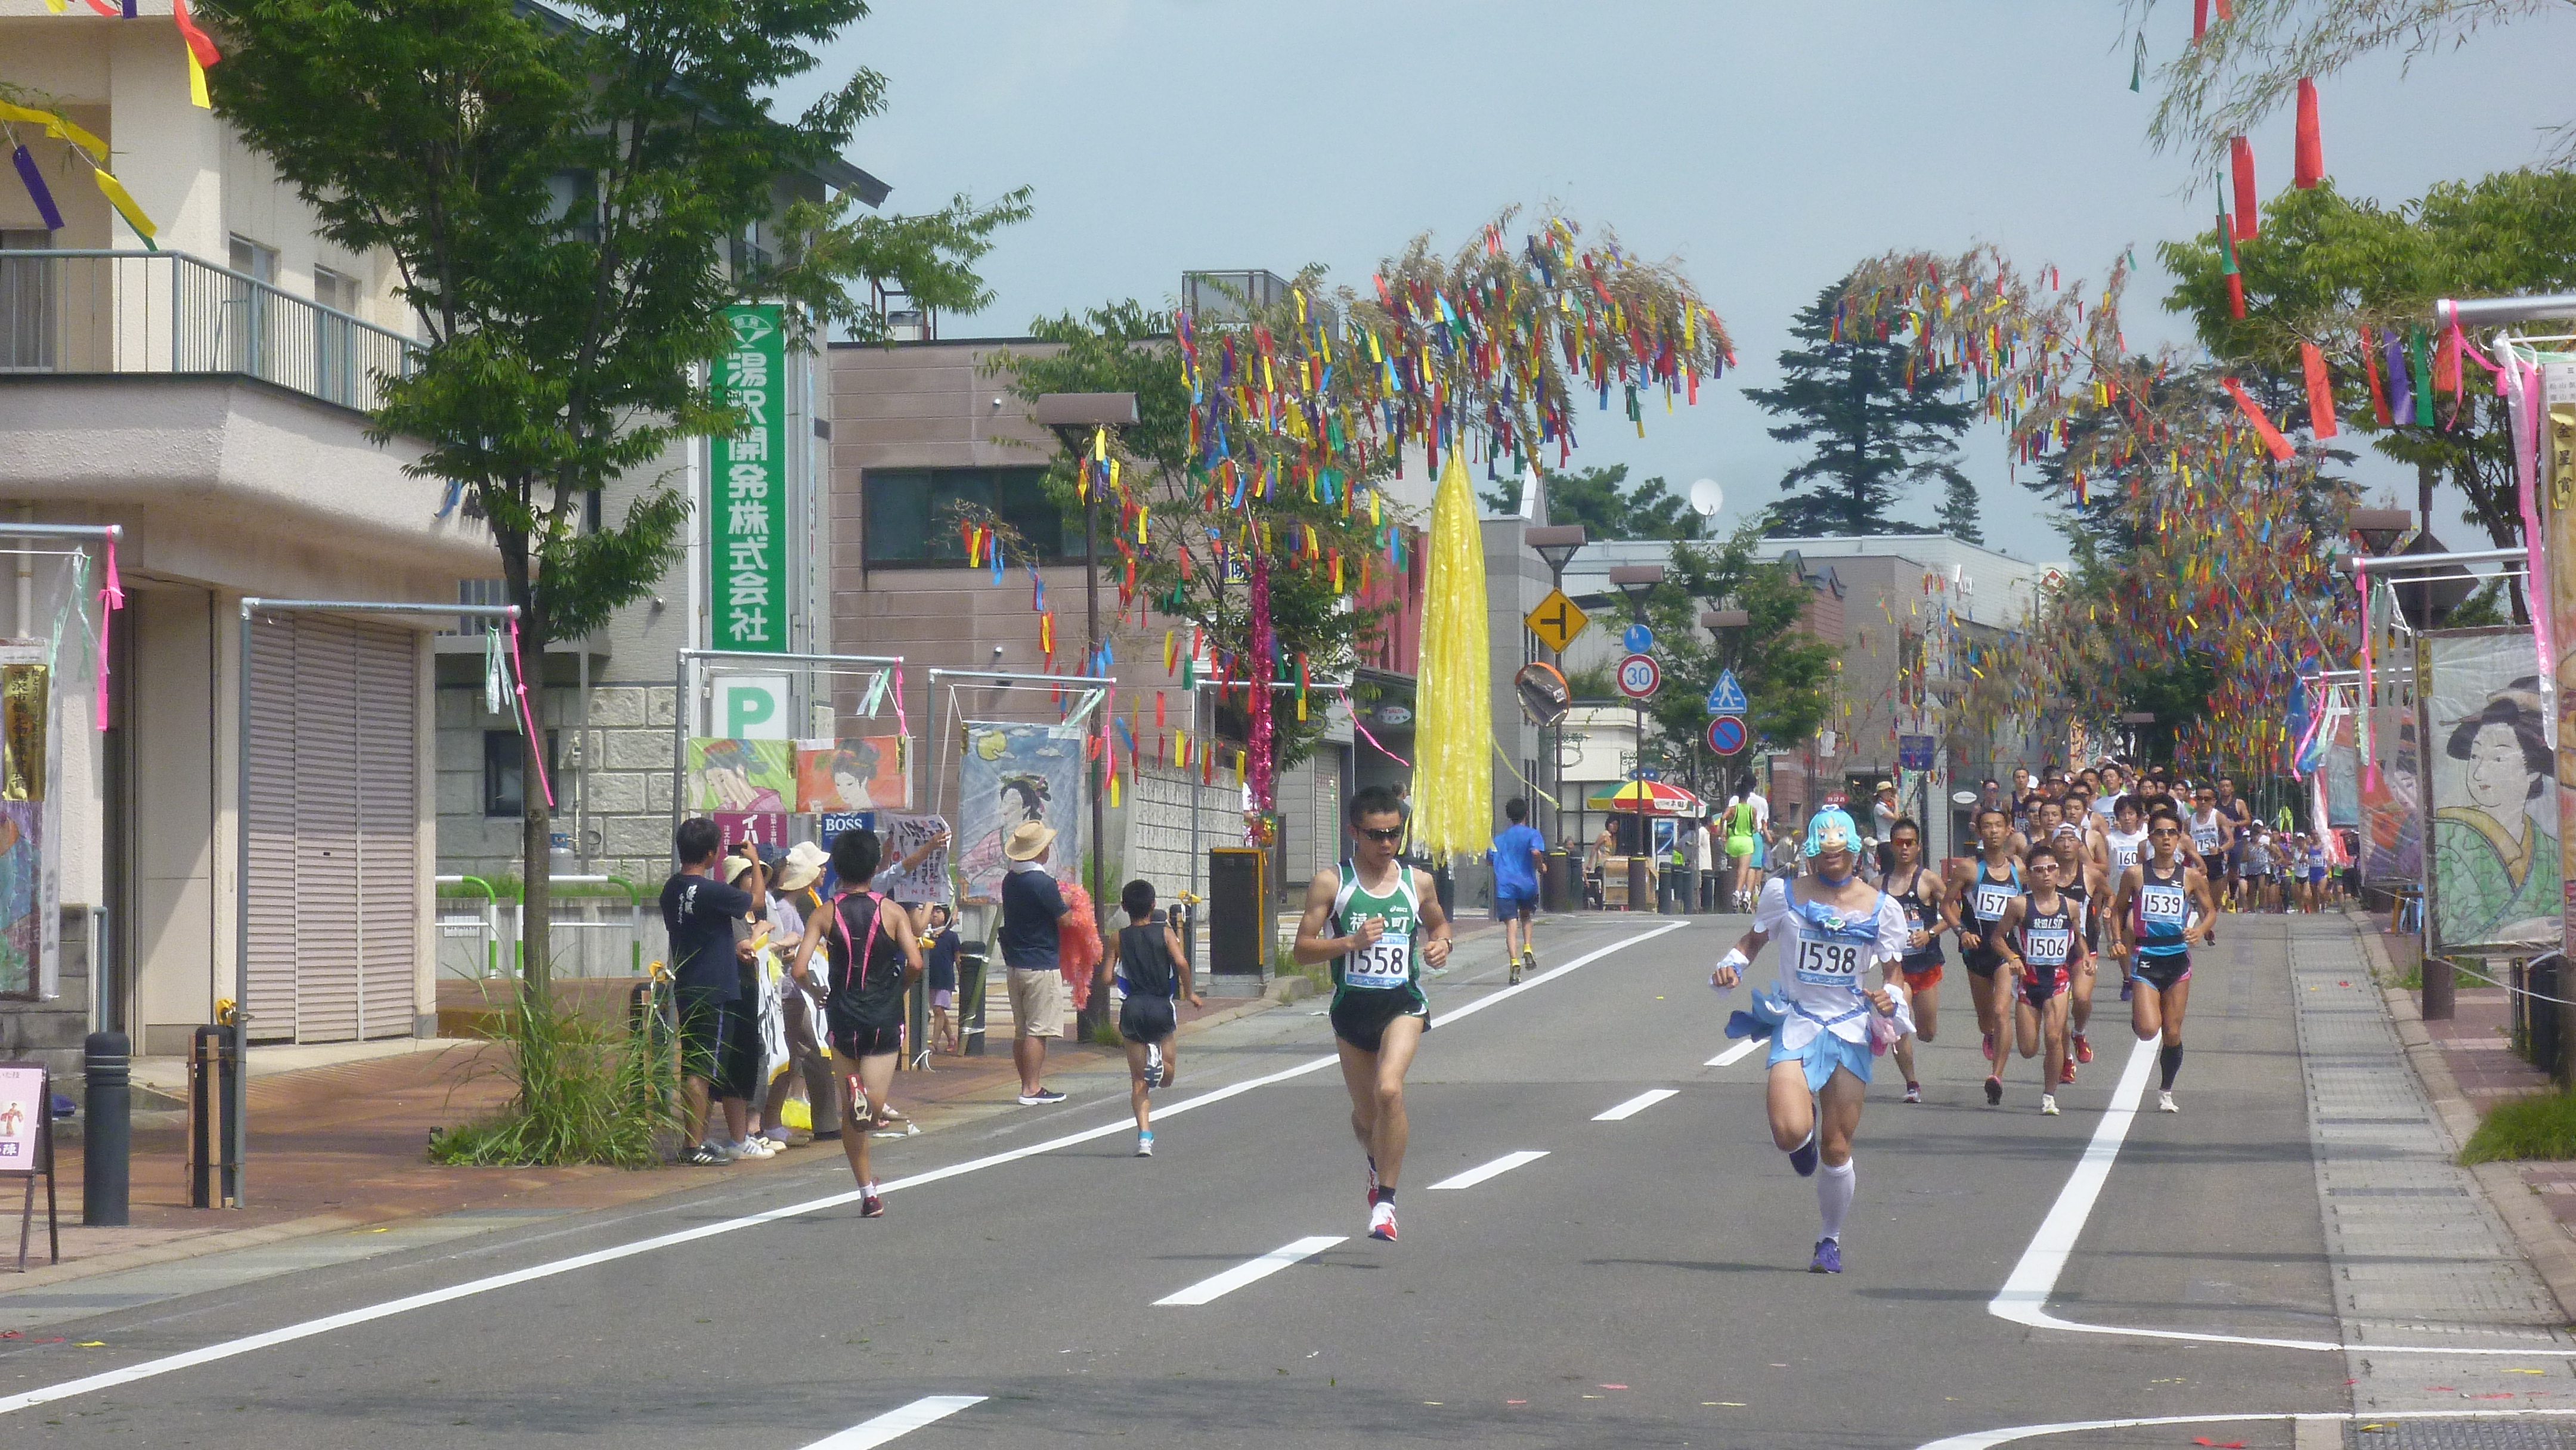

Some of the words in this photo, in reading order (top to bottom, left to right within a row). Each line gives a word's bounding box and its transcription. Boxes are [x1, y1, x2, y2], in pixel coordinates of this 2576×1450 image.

[2558, 423, 2572, 494] 金星賞
[727, 352, 769, 642] 湯沢開発株式会社
[1627, 667, 1649, 685] 30
[728, 687, 775, 739] P
[825, 819, 862, 832] BOSS
[2195, 838, 2217, 851] 1759
[2120, 852, 2138, 865] 160
[1980, 893, 2011, 913] 157
[2144, 894, 2180, 914] 1539
[2030, 938, 2064, 956] 1506
[1350, 947, 1403, 975] 1558
[1799, 941, 1856, 974] 1598
[0, 1144, 17, 1155] 陣
